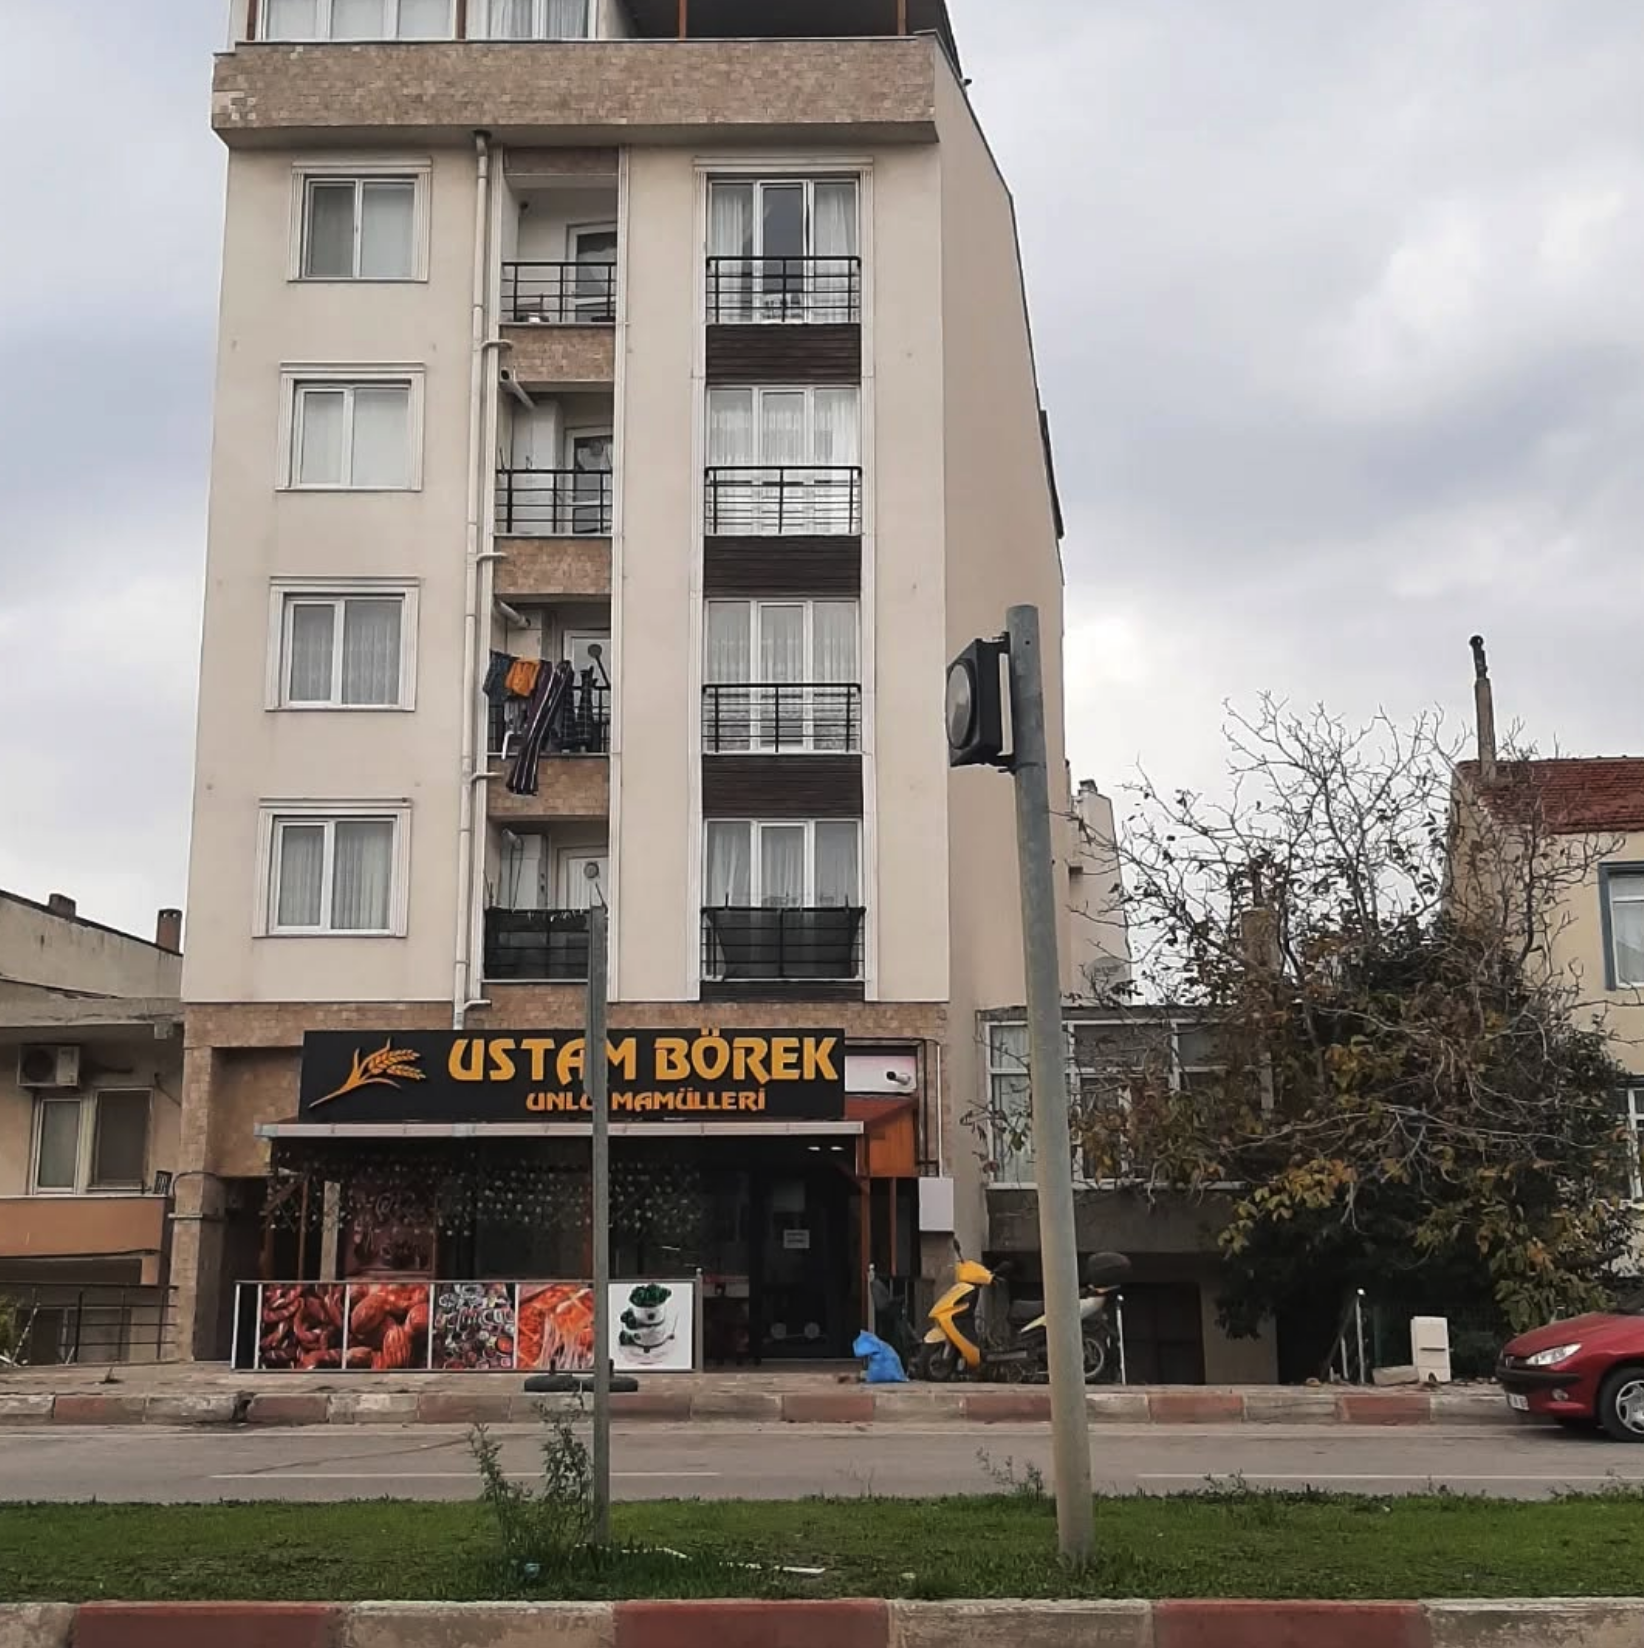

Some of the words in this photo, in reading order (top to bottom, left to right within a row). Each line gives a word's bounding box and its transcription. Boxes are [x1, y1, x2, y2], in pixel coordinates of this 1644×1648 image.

[448, 1037, 637, 1085] USTAM
[654, 1028, 839, 1084] BÖREK
[611, 1087, 766, 1112] MAMÜLLERİ
